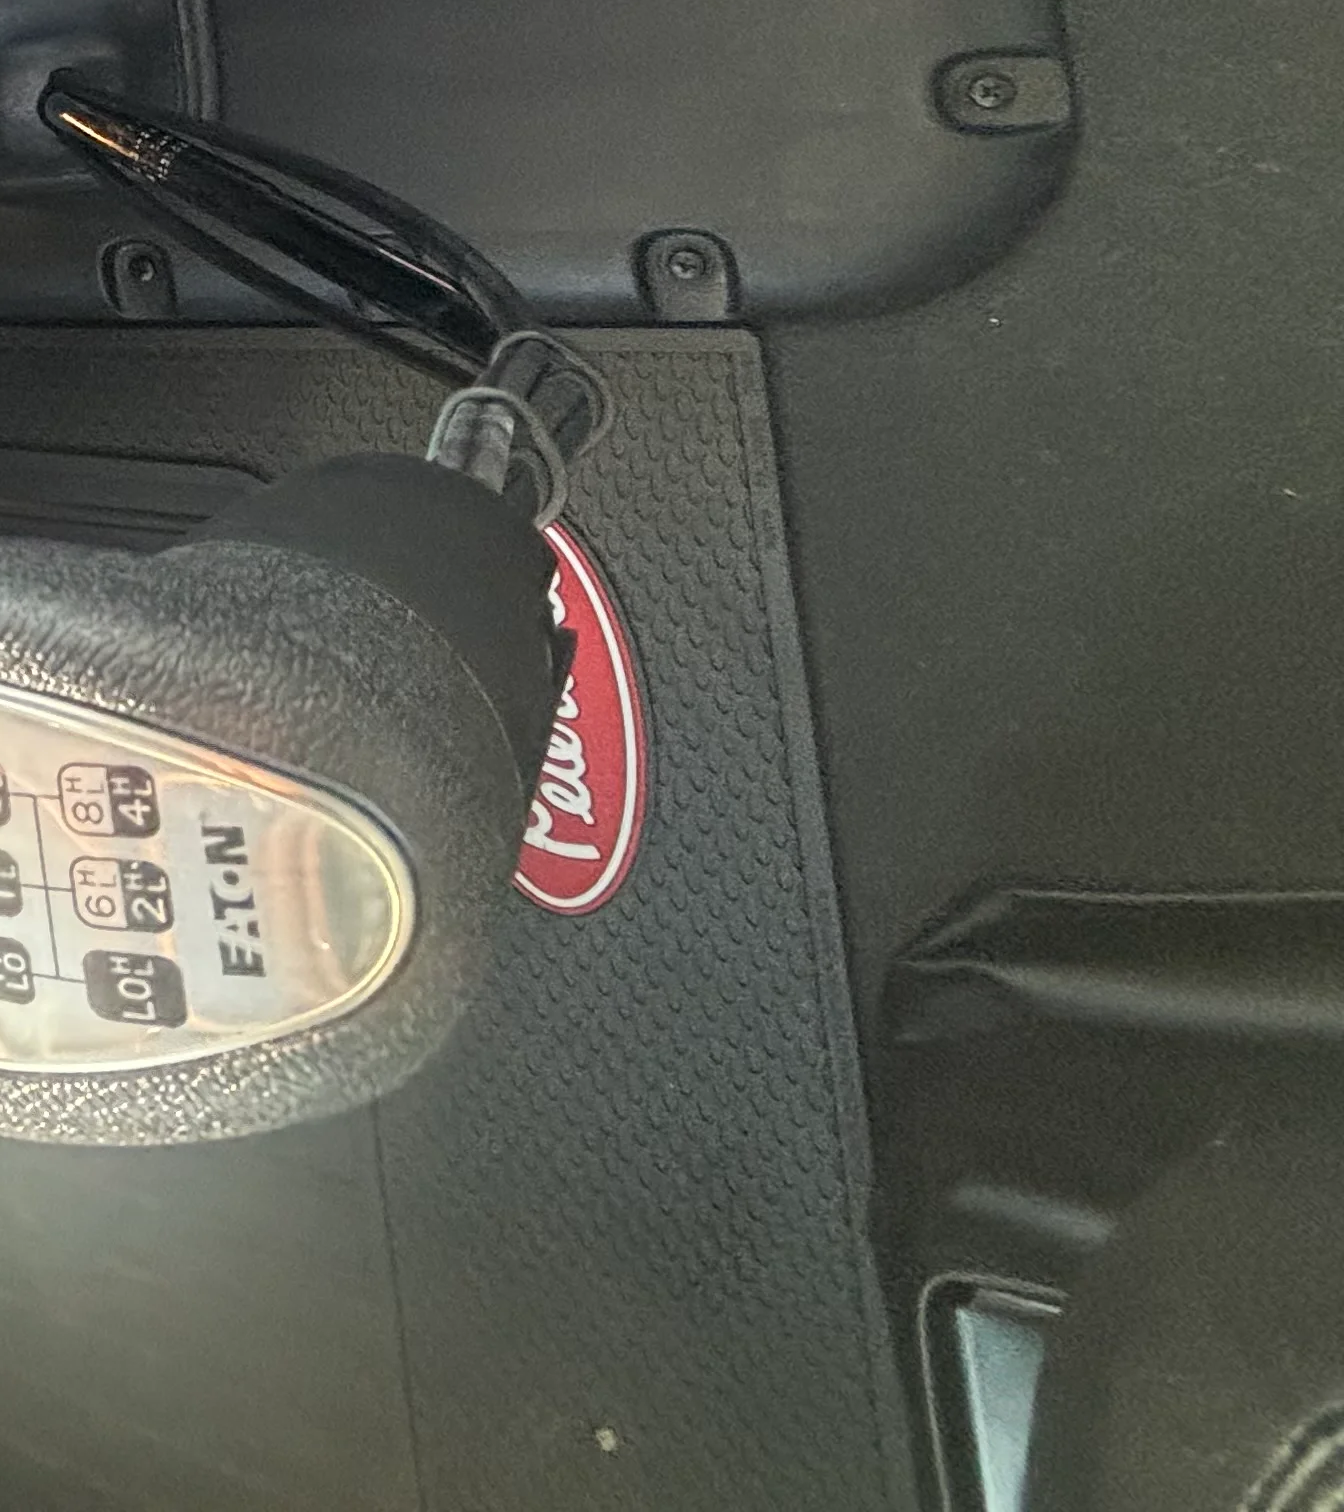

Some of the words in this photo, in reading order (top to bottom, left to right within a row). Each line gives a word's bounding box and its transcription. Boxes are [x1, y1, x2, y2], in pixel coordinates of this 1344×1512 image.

[72, 801, 104, 825] 8
[113, 799, 152, 826] 4
[85, 895, 116, 918] 6
[131, 897, 166, 924] 2
[201, 825, 267, 977] EATON
[4, 952, 29, 990] LO
[118, 977, 156, 1021] LO
